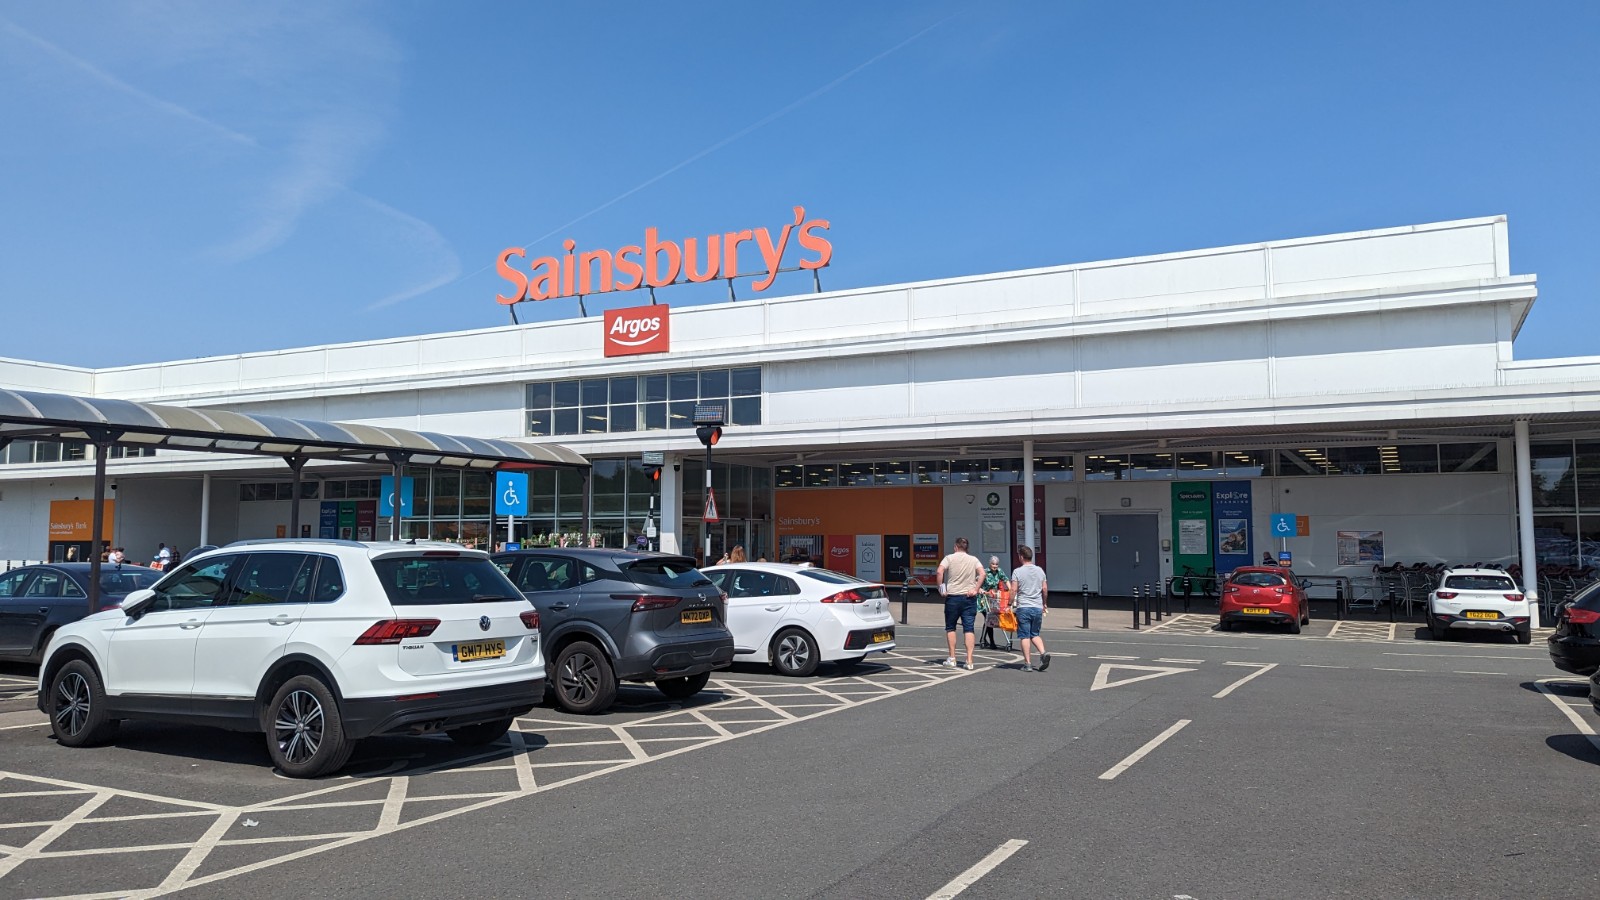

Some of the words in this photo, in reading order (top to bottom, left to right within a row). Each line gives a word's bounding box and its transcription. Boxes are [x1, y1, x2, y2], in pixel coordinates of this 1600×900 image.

[496, 205, 832, 305] Sainsbury's
[609, 315, 661, 338] Argos
[50, 522, 74, 531] Sainsbury's
[75, 521, 88, 529] Bank
[778, 516, 821, 527] Sainsbury's
[831, 546, 849, 555] Argos
[889, 546, 903, 559] Tu
[461, 644, 482, 658] GM17
[485, 643, 503, 656] HYS
